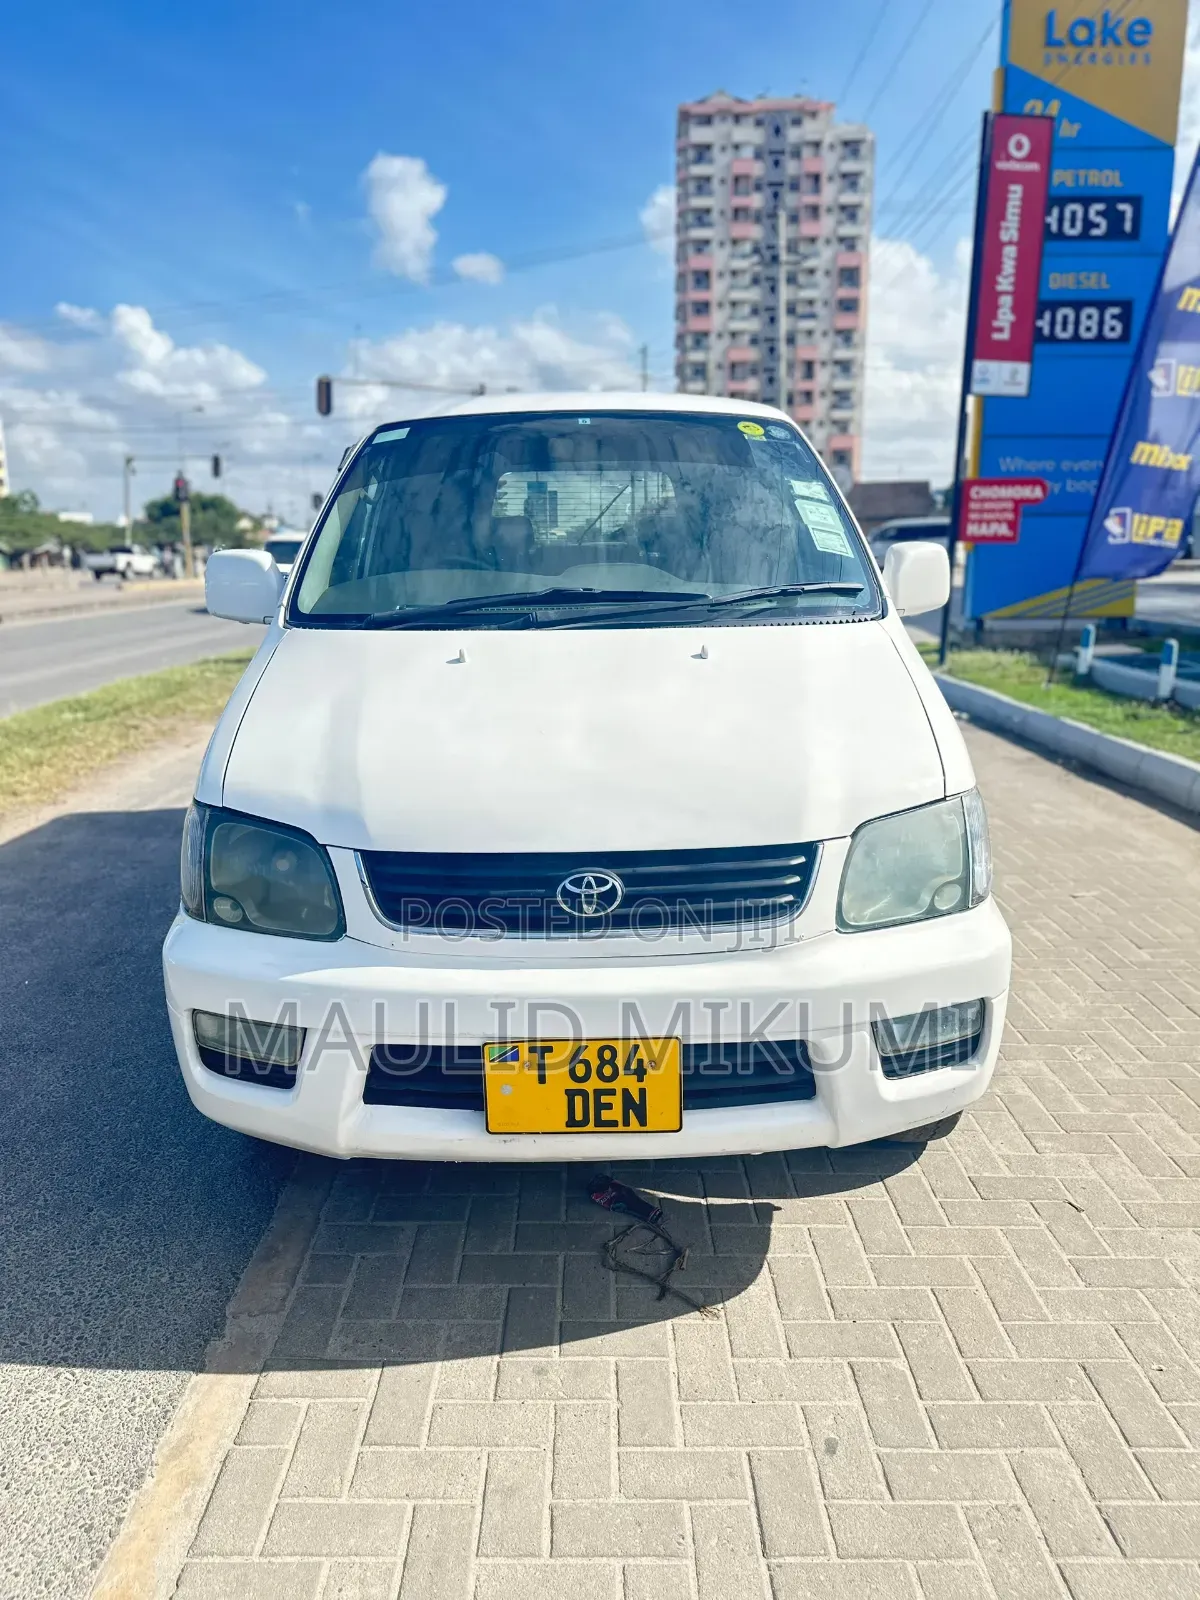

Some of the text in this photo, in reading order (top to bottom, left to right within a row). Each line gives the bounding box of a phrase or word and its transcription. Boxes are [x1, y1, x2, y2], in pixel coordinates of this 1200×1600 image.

[1044, 9, 1153, 48] Lake
[1053, 169, 1123, 187] PETROL
[991, 183, 1024, 341] Lipa Kwa Simu
[1049, 272, 1110, 290] DIESEL
[998, 456, 1055, 472] Where
[528, 1044, 648, 1084] T 684
[564, 1087, 648, 1128] DEN
